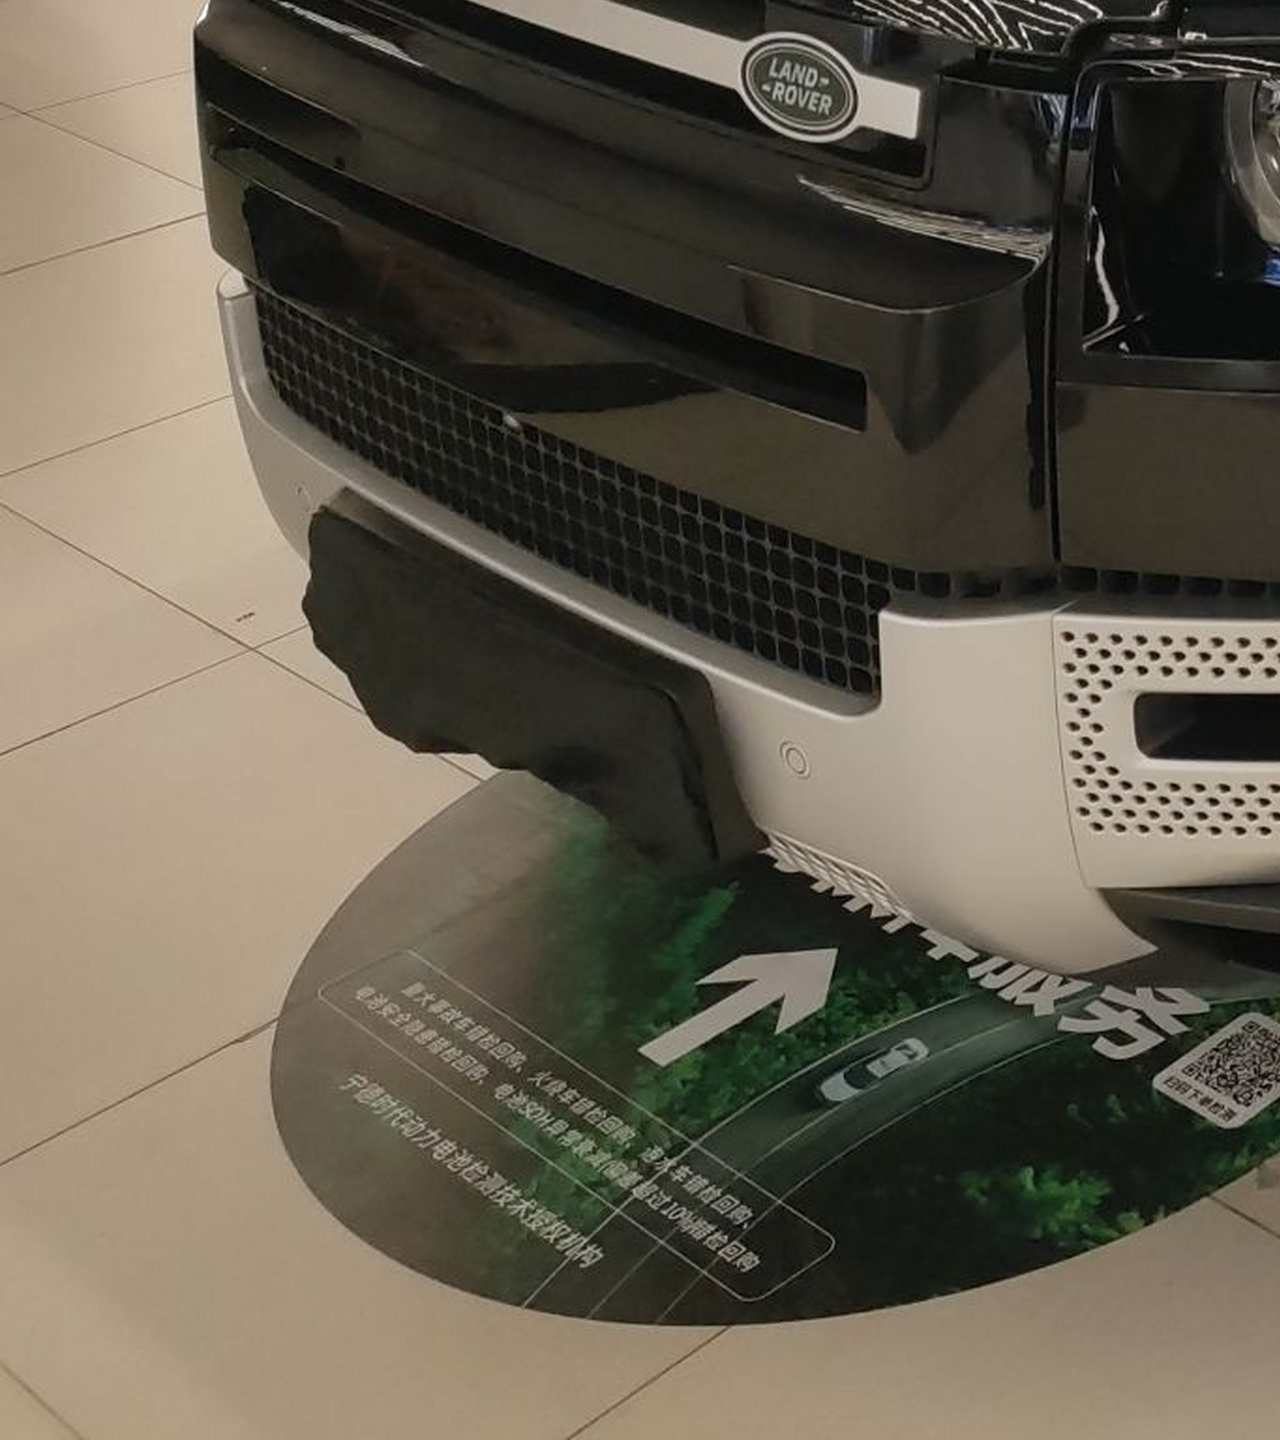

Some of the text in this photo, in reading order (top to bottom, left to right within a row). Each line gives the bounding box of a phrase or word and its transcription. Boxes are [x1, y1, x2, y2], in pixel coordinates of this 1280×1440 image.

[768, 57, 819, 88] LAND
[771, 81, 833, 116] ROVER
[338, 1073, 603, 1269] 宁德时代动力电池检测技术授权机构
